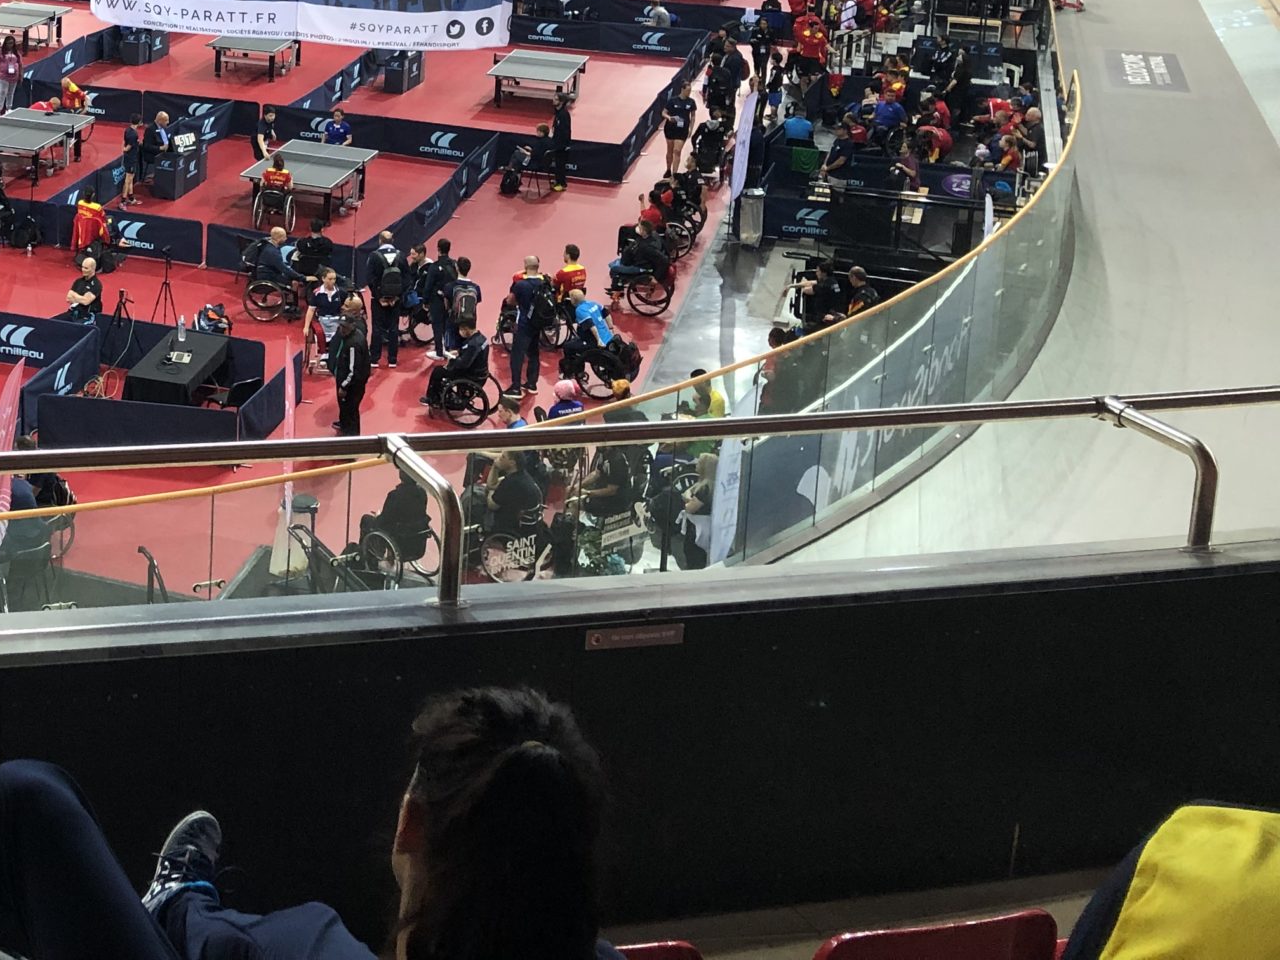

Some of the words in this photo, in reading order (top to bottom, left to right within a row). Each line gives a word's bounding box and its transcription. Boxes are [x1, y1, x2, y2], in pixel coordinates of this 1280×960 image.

[349, 21, 440, 35] #SQYPARATT
[527, 34, 565, 43] cornilleau
[632, 43, 671, 52] cornilleau
[419, 145, 465, 158] cornilleau
[506, 534, 537, 552] SAINT
[490, 546, 536, 564] QUENTIN
